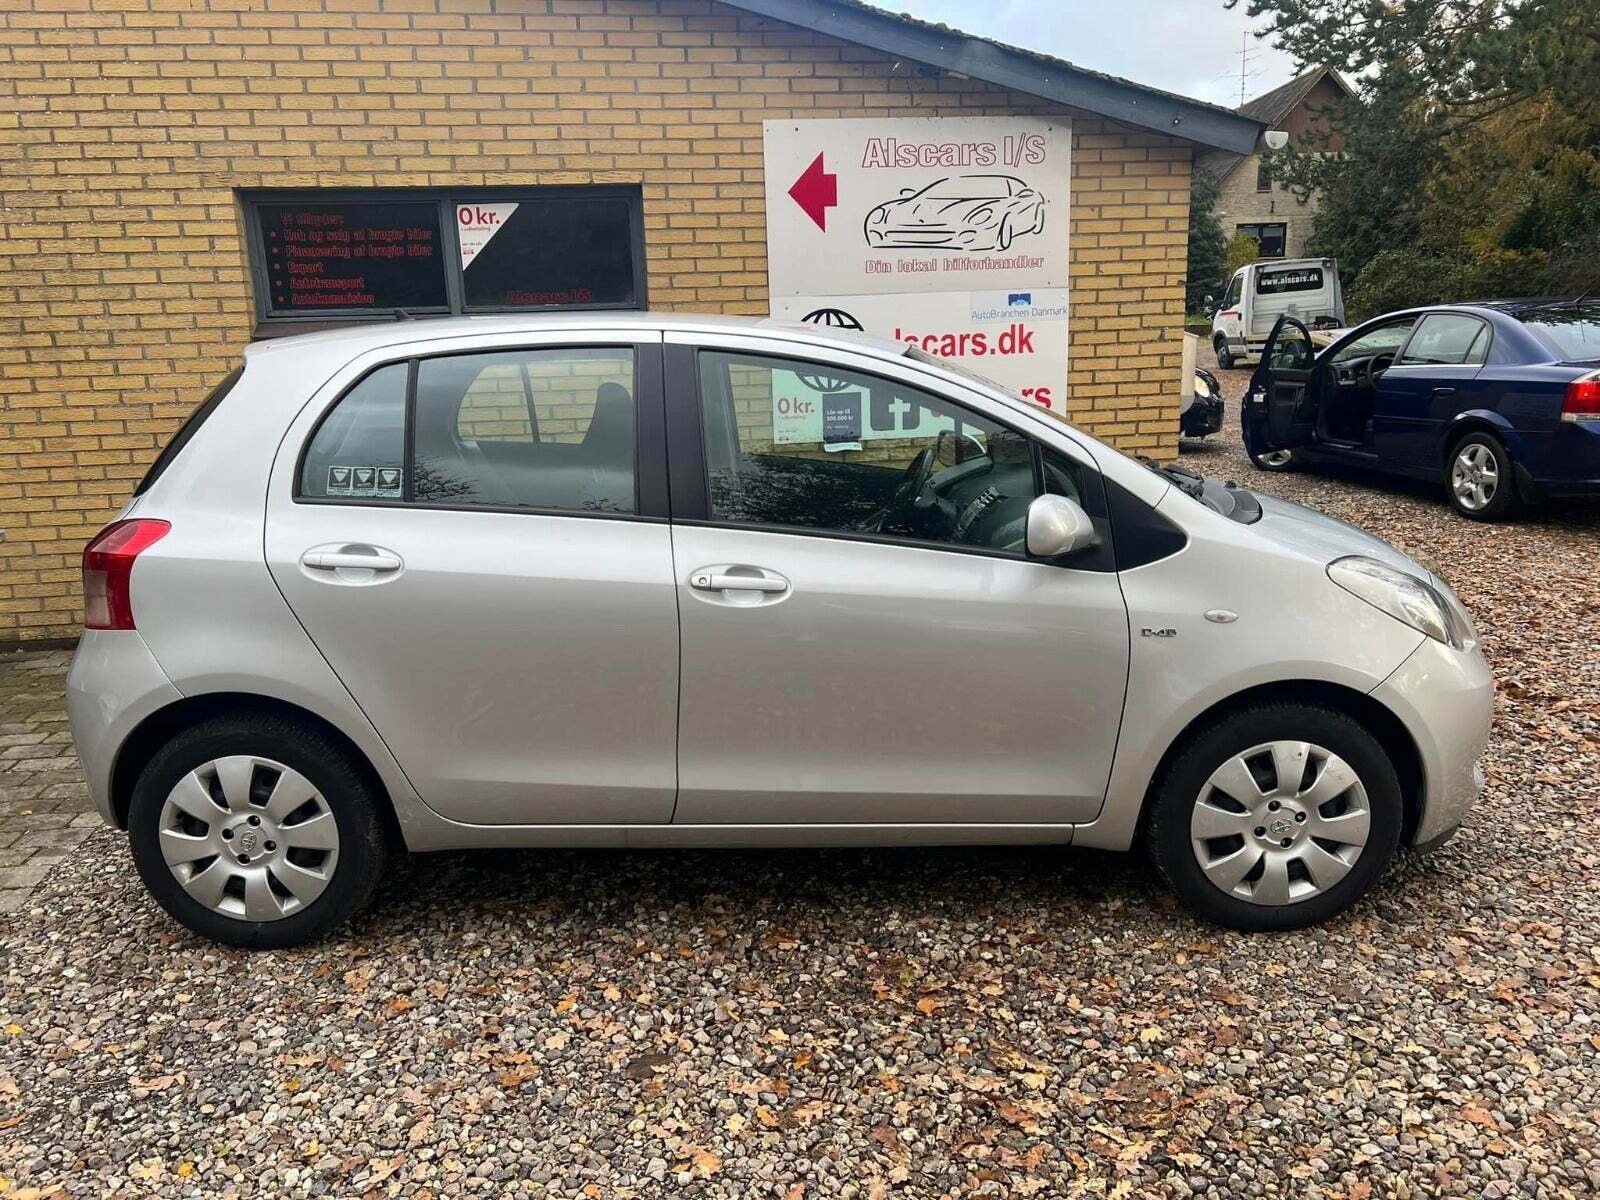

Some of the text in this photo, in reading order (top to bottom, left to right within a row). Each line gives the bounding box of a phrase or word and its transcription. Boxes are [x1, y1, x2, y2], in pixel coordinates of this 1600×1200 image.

[862, 132, 1046, 168] Alscars I/S
[459, 205, 500, 226] 0 kr.
[865, 256, 1045, 273] Din lokal bilforhandler
[1261, 273, 1319, 286] www.alscars.dk
[971, 306, 1068, 320] AutoBranchen Danmark
[777, 397, 815, 414] 0 kr.
